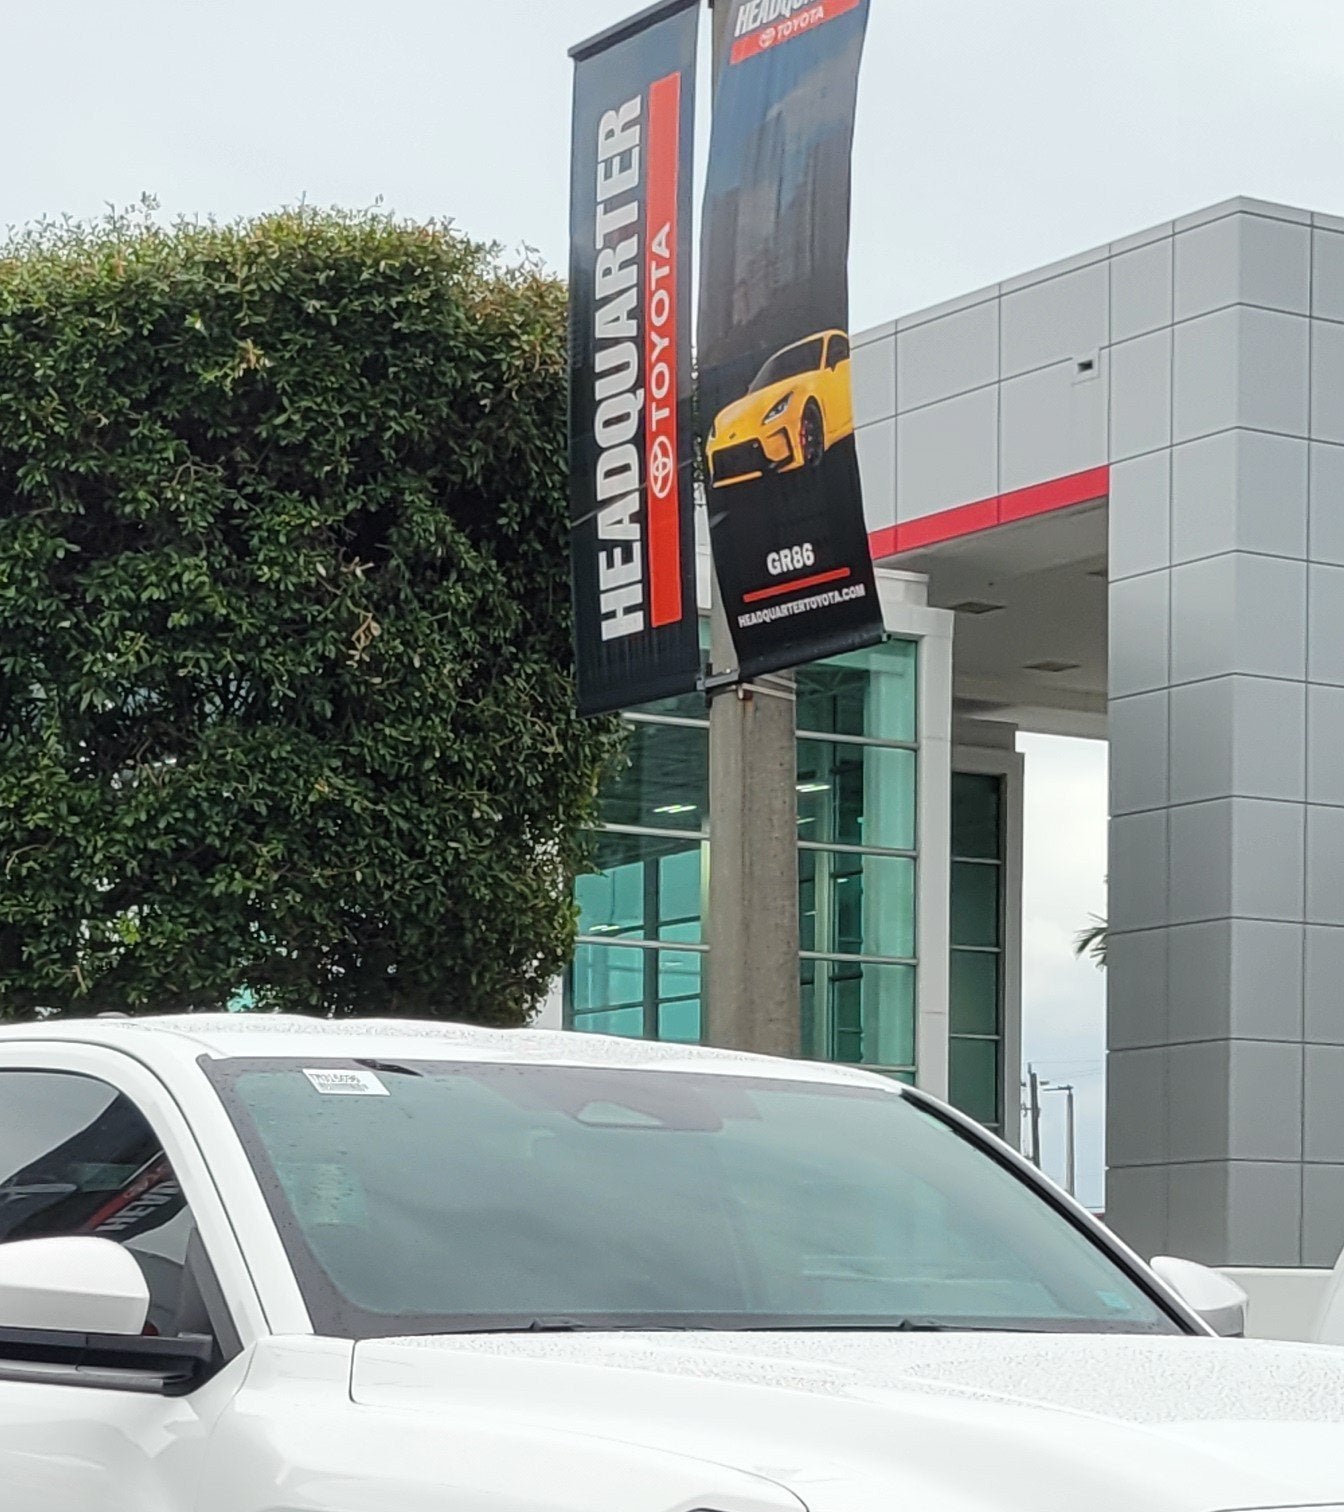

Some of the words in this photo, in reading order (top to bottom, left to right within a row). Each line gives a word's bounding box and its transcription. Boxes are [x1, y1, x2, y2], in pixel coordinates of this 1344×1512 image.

[776, 6, 824, 40] TOYOTA
[650, 222, 674, 430] TOYOTA
[594, 94, 644, 642] HEADQUARTER
[766, 542, 815, 576] GR86
[737, 583, 866, 629] HEADQUARTERTOYOTA.COM
